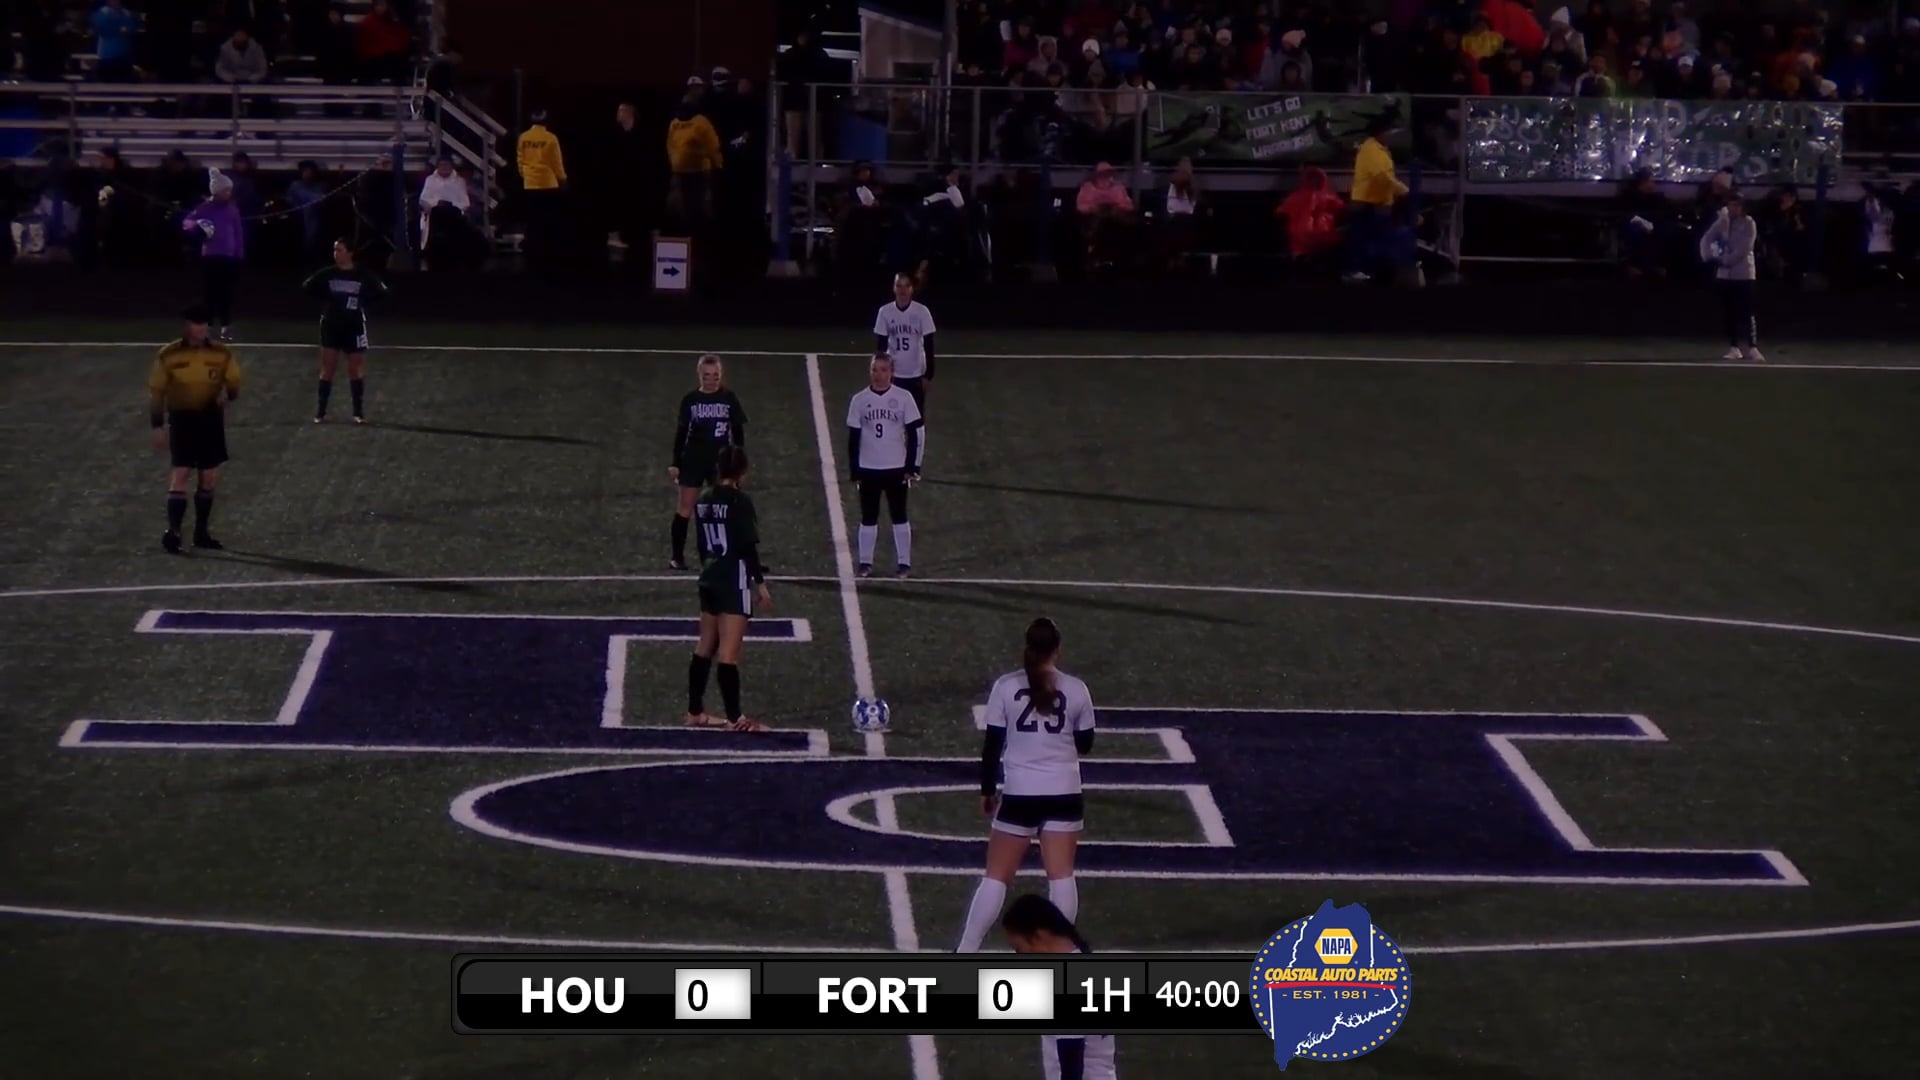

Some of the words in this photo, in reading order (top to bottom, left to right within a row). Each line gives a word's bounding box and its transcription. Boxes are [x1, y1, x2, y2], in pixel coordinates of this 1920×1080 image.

[1247, 101, 1282, 120] LET'S
[1284, 96, 1301, 111] GO
[1246, 123, 1276, 140] FORT
[1280, 114, 1311, 132] KENT
[896, 337, 910, 351] 15
[864, 408, 899, 423] SHIRES
[875, 423, 883, 438] 9
[702, 523, 729, 557] 14
